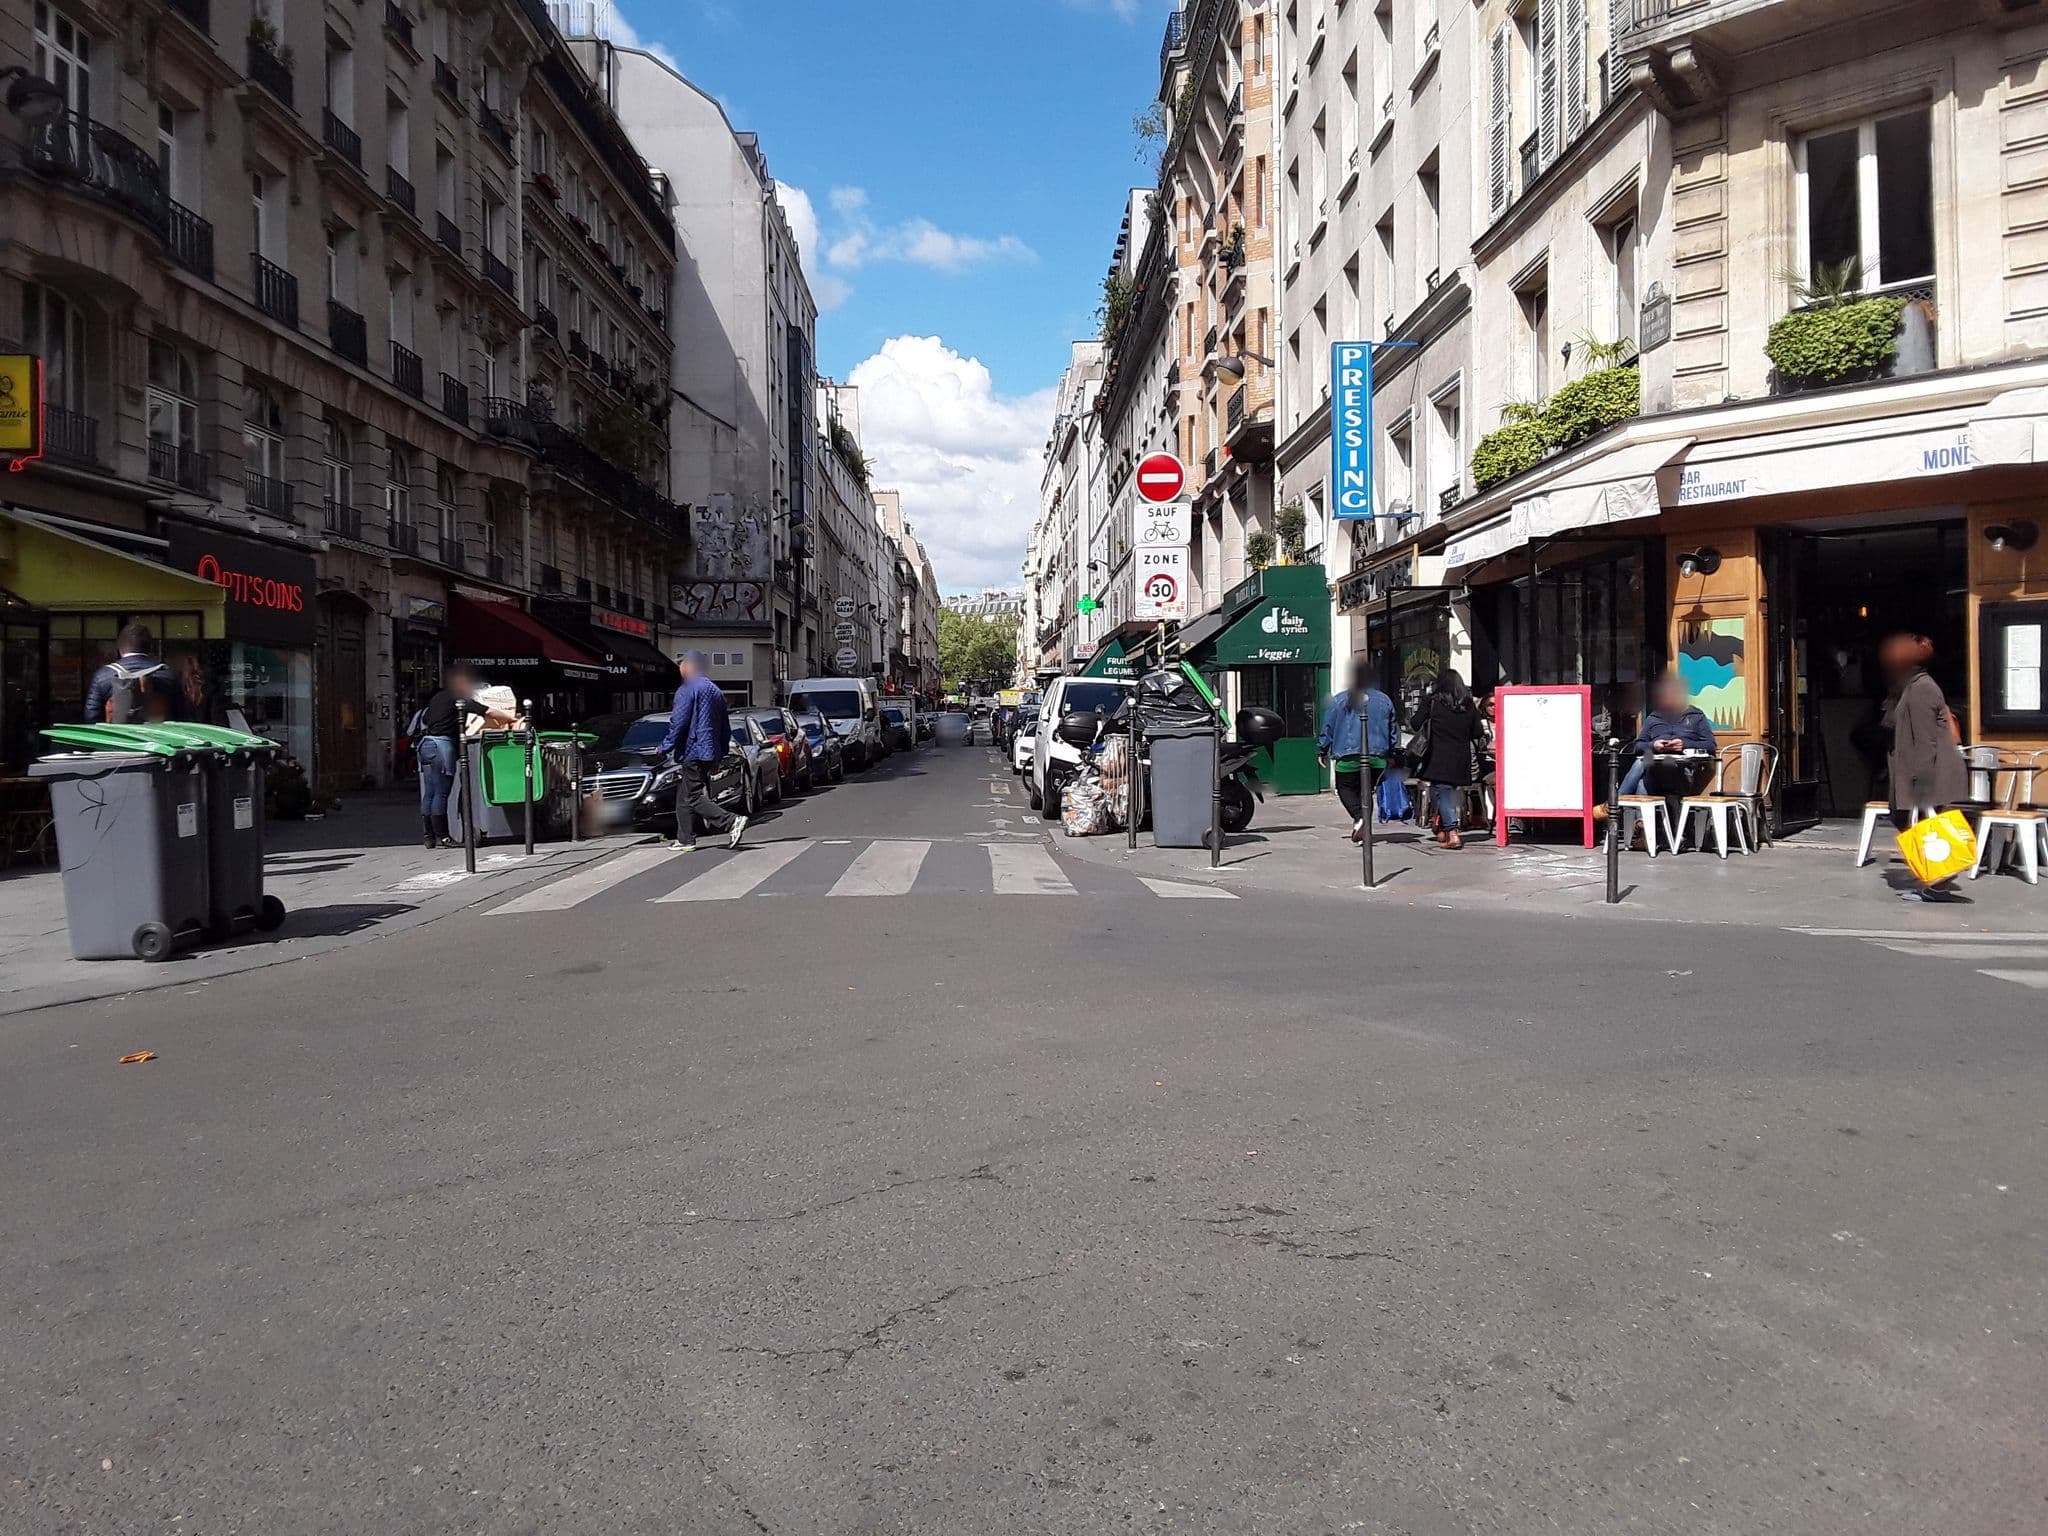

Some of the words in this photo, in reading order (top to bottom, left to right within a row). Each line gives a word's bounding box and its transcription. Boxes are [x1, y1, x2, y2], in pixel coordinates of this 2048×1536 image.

[1341, 347, 1368, 509] PRESSING
[1957, 434, 1968, 445] LE
[1680, 471, 1701, 485] BAR
[1679, 479, 1746, 500] RESTAURANT
[1147, 507, 1178, 518] SAUF
[1144, 554, 1180, 565] ZONE
[1151, 584, 1172, 598] 30
[1281, 616, 1304, 627] daily
[1281, 626, 1308, 636] syrien
